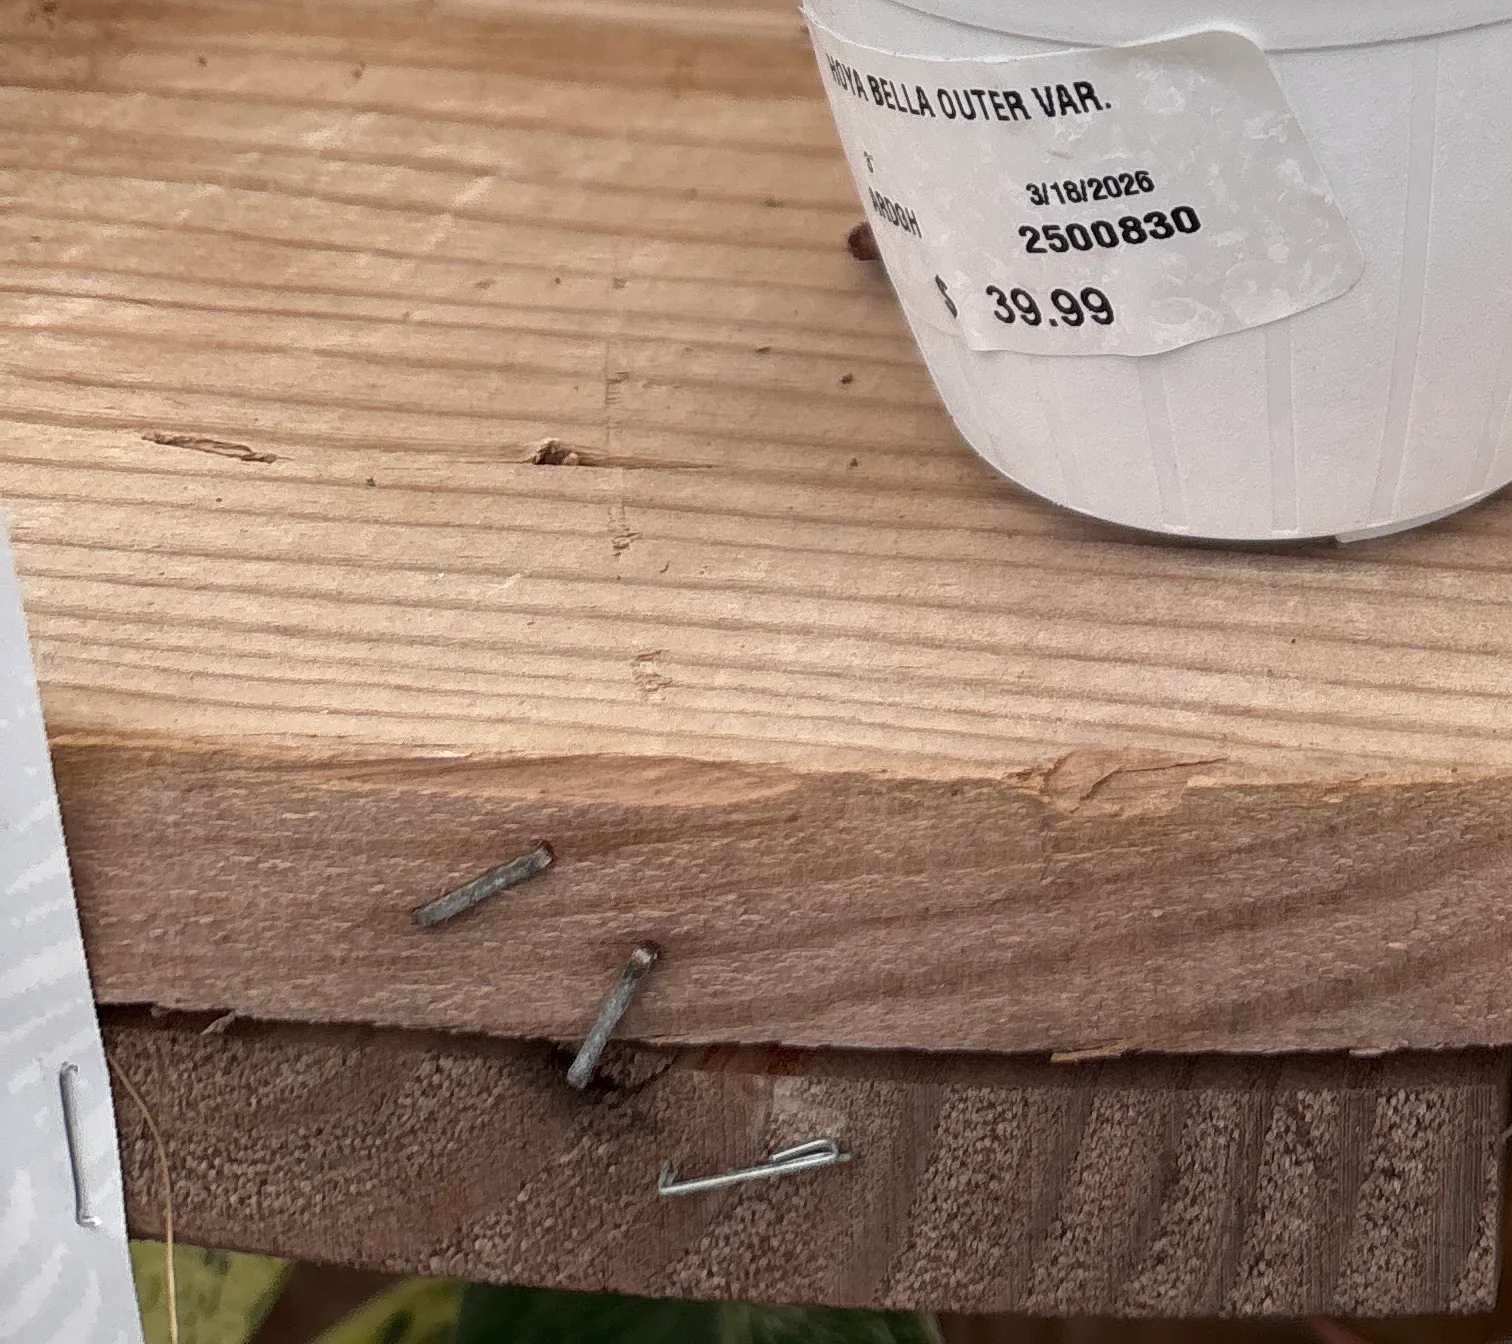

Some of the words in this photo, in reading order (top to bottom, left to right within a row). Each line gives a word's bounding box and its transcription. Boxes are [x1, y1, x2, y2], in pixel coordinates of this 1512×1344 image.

[825, 52, 869, 102] HOYA
[866, 74, 936, 118] BELLA
[936, 87, 1033, 121] OUTER
[1030, 80, 1112, 118] VAR.
[868, 185, 923, 239] ARDGH
[1025, 170, 1155, 206] 3/18/2026
[1017, 205, 1202, 254] 2500830
[934, 273, 959, 320] $
[985, 284, 1115, 327] 39.99
